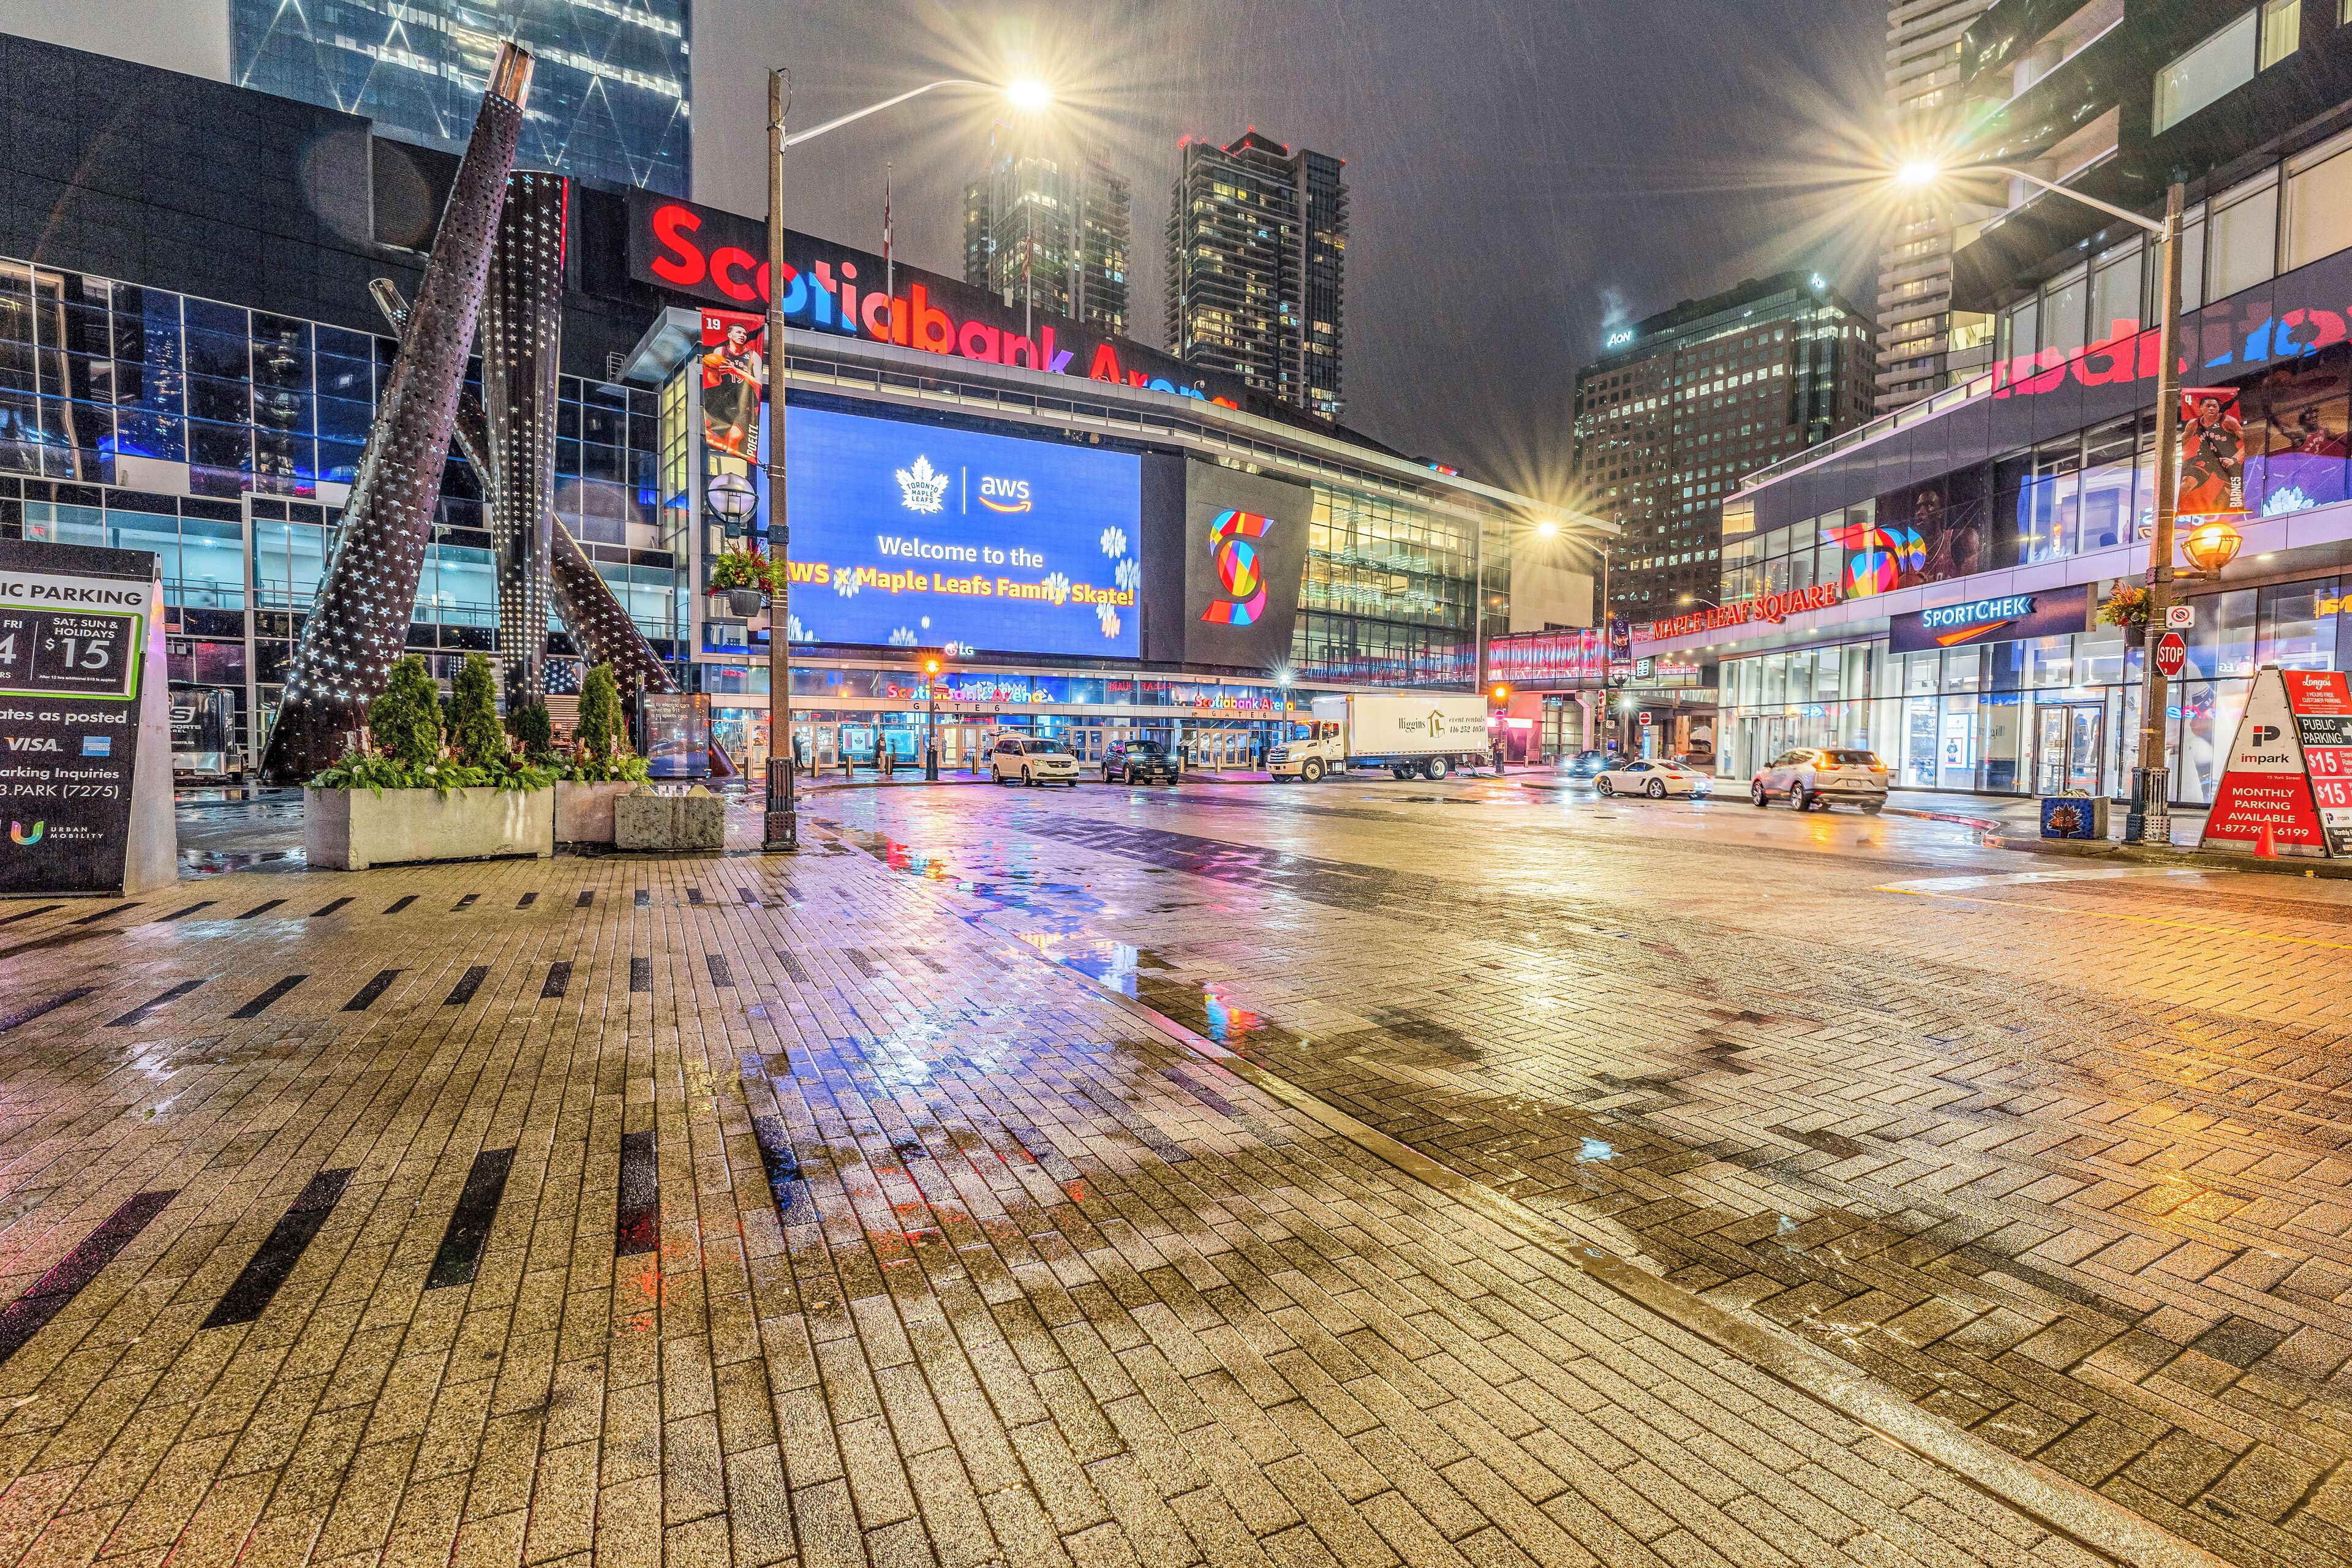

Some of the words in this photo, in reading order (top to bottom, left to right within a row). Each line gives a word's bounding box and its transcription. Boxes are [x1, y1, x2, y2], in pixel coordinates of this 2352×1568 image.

[651, 205, 1074, 374] Scotiabank
[706, 318, 720, 330] 19
[2185, 395, 2192, 405] 4
[747, 424, 758, 458] POELTL
[907, 482, 938, 493] TORONTO
[981, 477, 1030, 499] aws
[2230, 477, 2242, 508] BARNES
[878, 535, 977, 562] Welcome
[982, 546, 1005, 565] to
[1010, 548, 1043, 567] the
[834, 569, 850, 585] x
[856, 567, 928, 593] Maple
[933, 573, 992, 596] Leafs
[997, 578, 1066, 605] Family
[1071, 584, 1134, 606] Skate!
[31, 585, 143, 606] PARKING
[1653, 612, 1702, 641] MAPLE
[1705, 600, 1750, 631] LEAF
[1753, 582, 1838, 624] SQUARE
[4, 620, 23, 629] FRI
[53, 617, 77, 627] SAT,
[81, 619, 107, 629] SUN
[109, 621, 119, 630] &
[55, 628, 115, 638] HOLIDAYS
[959, 646, 974, 655] LG
[2159, 646, 2184, 663] STOP
[1196, 695, 1259, 709] Scotiabank
[1261, 698, 1295, 711] Arena
[39, 712, 60, 722] as
[65, 710, 127, 725] posted
[2303, 719, 2335, 730] PUBLIC
[1398, 718, 1426, 733] Higgins
[4, 737, 58, 752] VISA
[2303, 732, 2343, 744] PARKING
[2241, 753, 2289, 764] impark
[2309, 752, 2337, 773] $15
[55, 767, 119, 781] Inquiries
[63, 785, 119, 799] (7275)
[2233, 788, 2294, 797] MONTHLY
[2317, 783, 2345, 804] $15
[2235, 800, 2290, 810] PARKING
[2228, 812, 2296, 823] AVAILABLE
[2215, 823, 2309, 837] 1-877-9-6199
